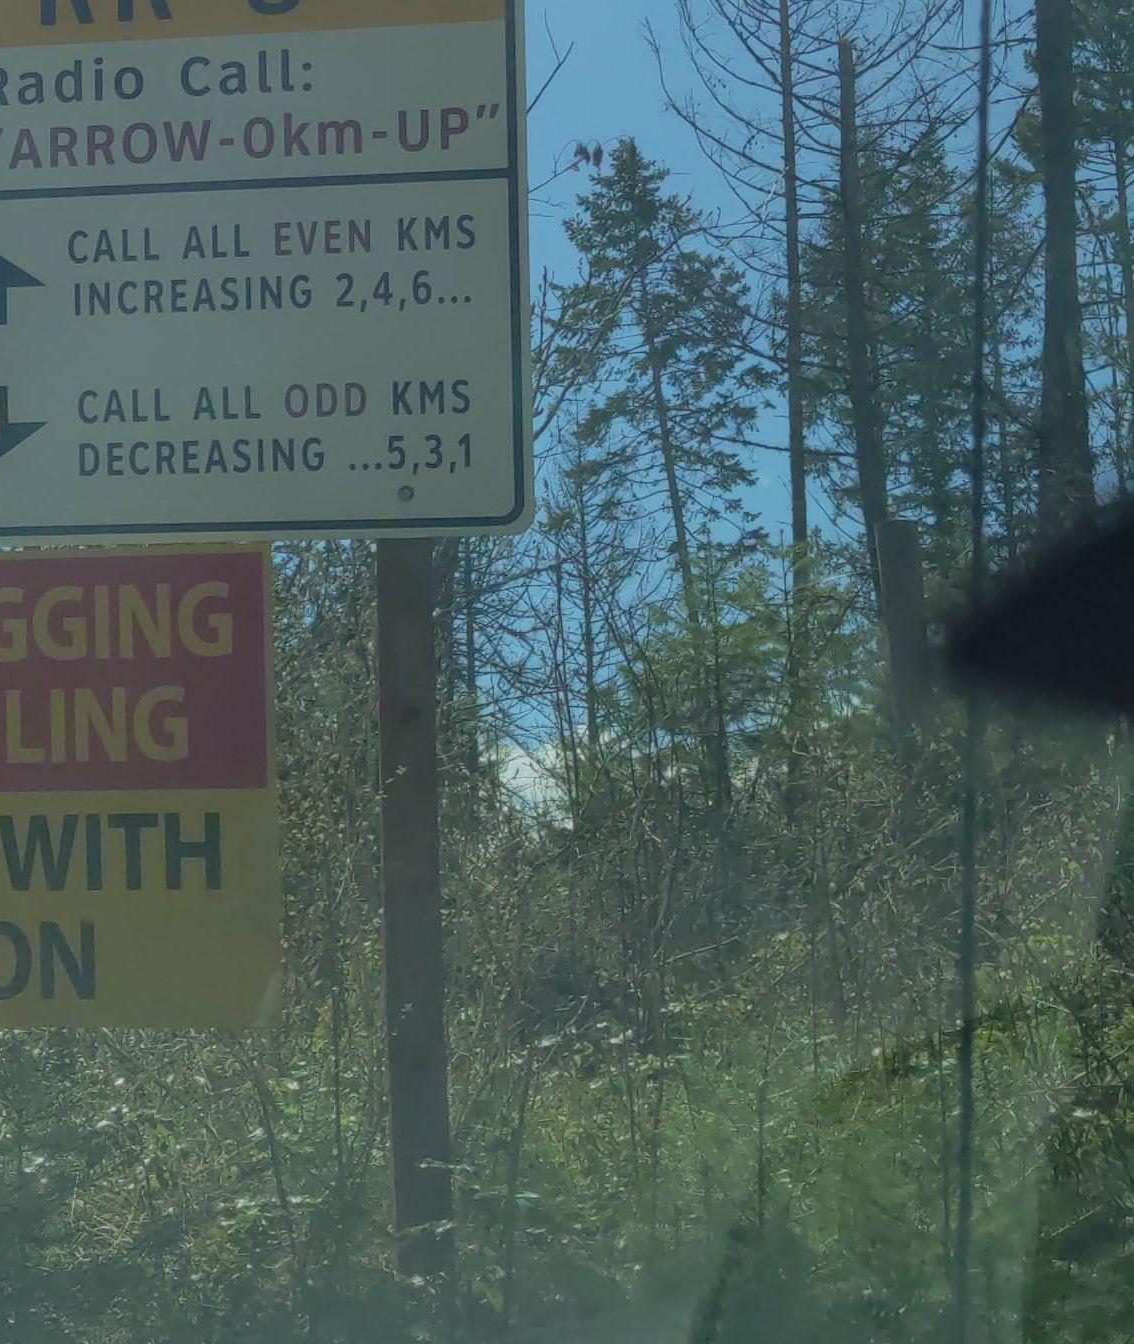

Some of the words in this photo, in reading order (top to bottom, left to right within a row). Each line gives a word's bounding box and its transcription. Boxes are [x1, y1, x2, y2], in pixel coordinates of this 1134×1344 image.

[180, 49, 312, 96] Call:
[68, 227, 159, 263] CALL
[182, 224, 250, 259] ALL
[274, 219, 371, 255] EVEN
[397, 214, 476, 251] KMS
[74, 274, 312, 316] INCREASING
[335, 270, 472, 312] 2,4,6...
[77, 387, 170, 424] CALL
[193, 386, 261, 420] ALL
[284, 382, 367, 418] ODD
[392, 379, 471, 415] KMS
[78, 437, 325, 476] DECREASING
[349, 434, 471, 475] ...5,3,1
